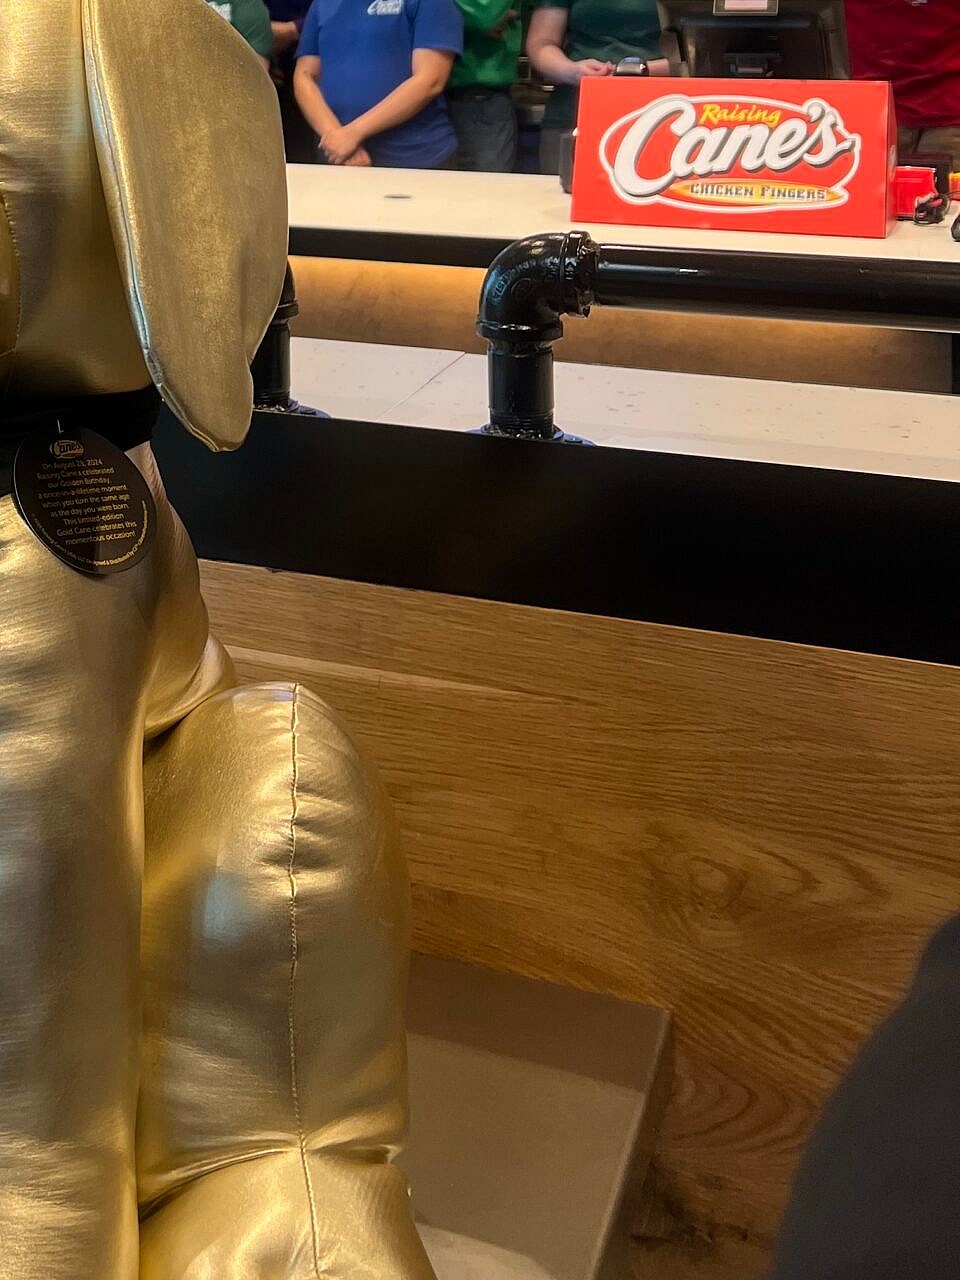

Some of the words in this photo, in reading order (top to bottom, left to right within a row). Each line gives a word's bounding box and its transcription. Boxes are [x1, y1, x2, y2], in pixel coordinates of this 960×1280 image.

[700, 103, 781, 127] Raising
[614, 98, 856, 196] Cane's
[691, 183, 754, 197] CHICKEN
[761, 185, 828, 200] FINGERS
[62, 498, 75, 508] you
[84, 507, 96, 517] you
[56, 527, 74, 537] Gold
[74, 526, 91, 535] Cane
